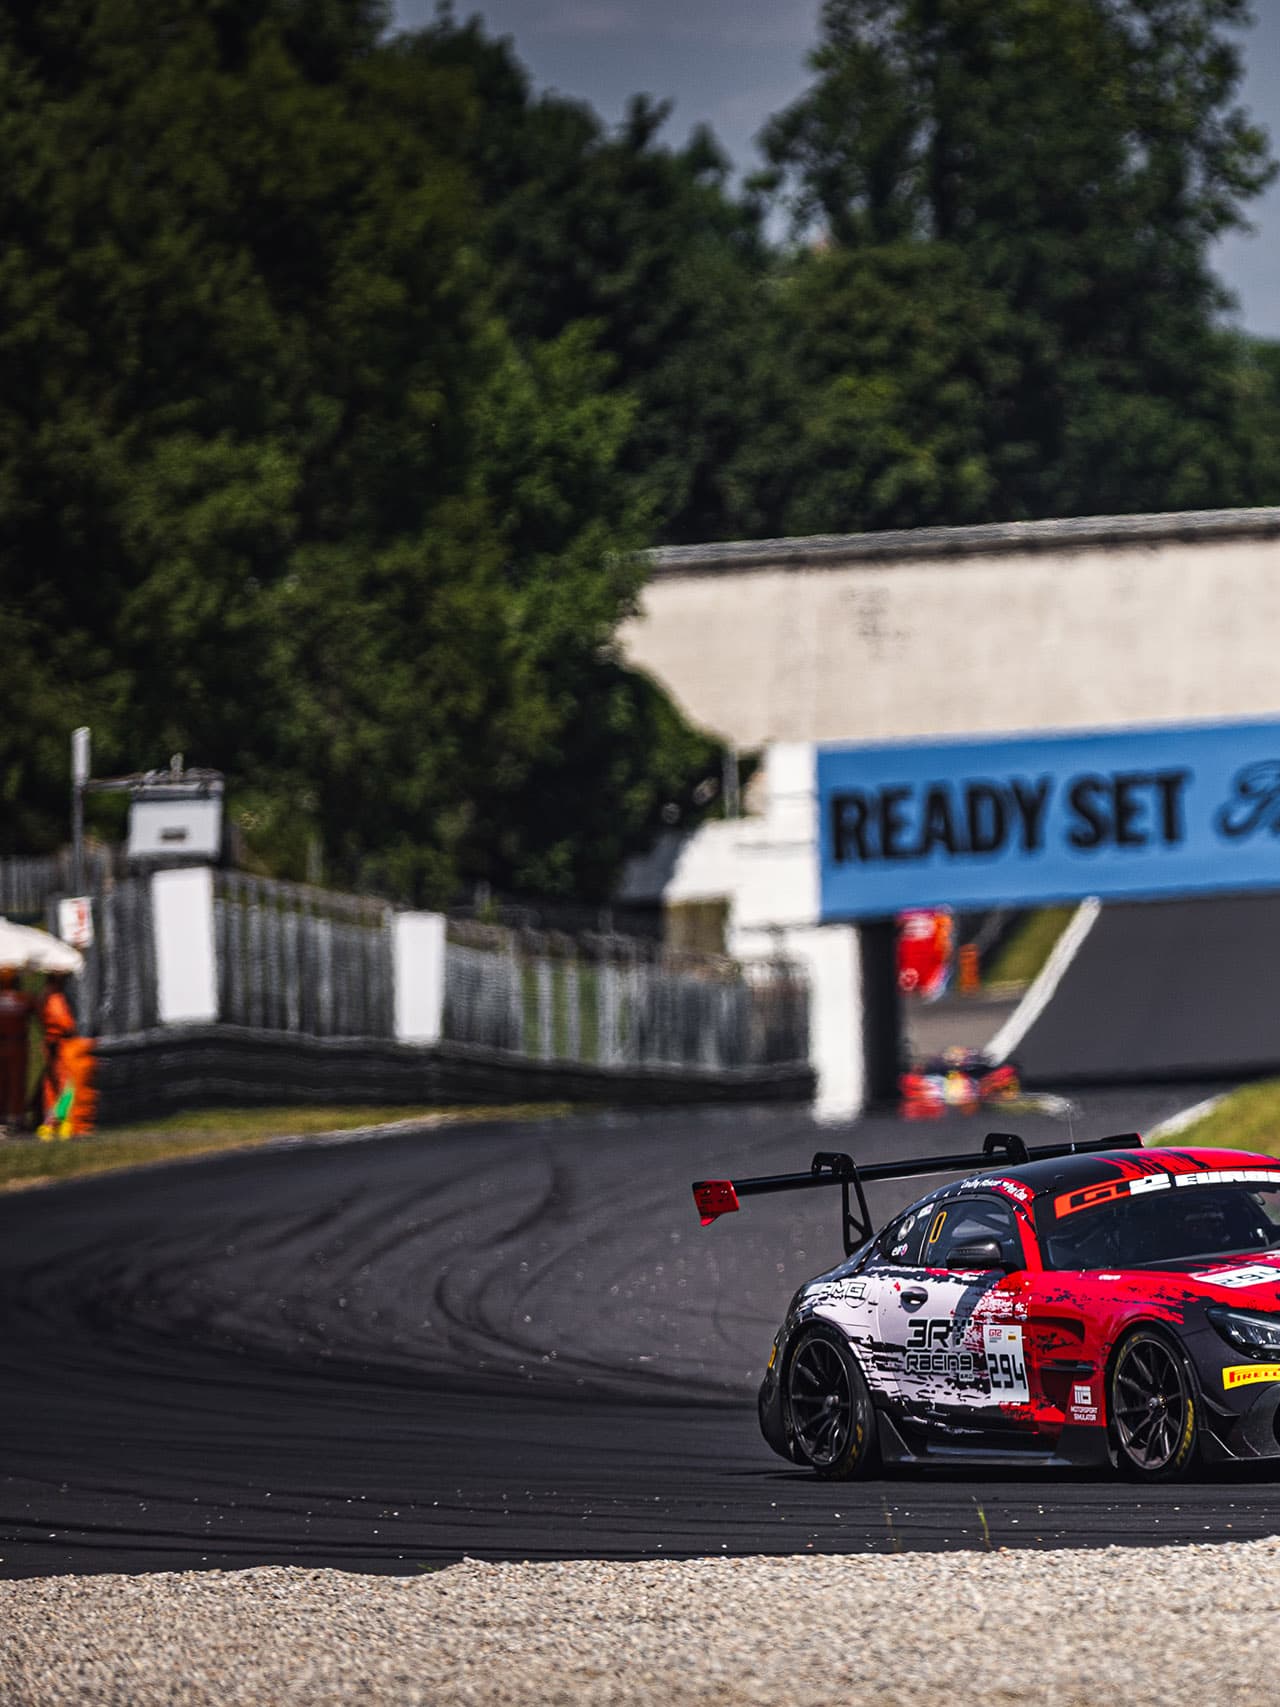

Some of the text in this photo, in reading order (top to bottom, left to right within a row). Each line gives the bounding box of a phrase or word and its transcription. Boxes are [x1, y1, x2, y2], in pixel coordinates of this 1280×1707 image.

[828, 772, 1050, 864] READY
[1066, 767, 1192, 852] SET
[818, 1280, 867, 1301] AMG
[986, 1352, 1028, 1391] 294
